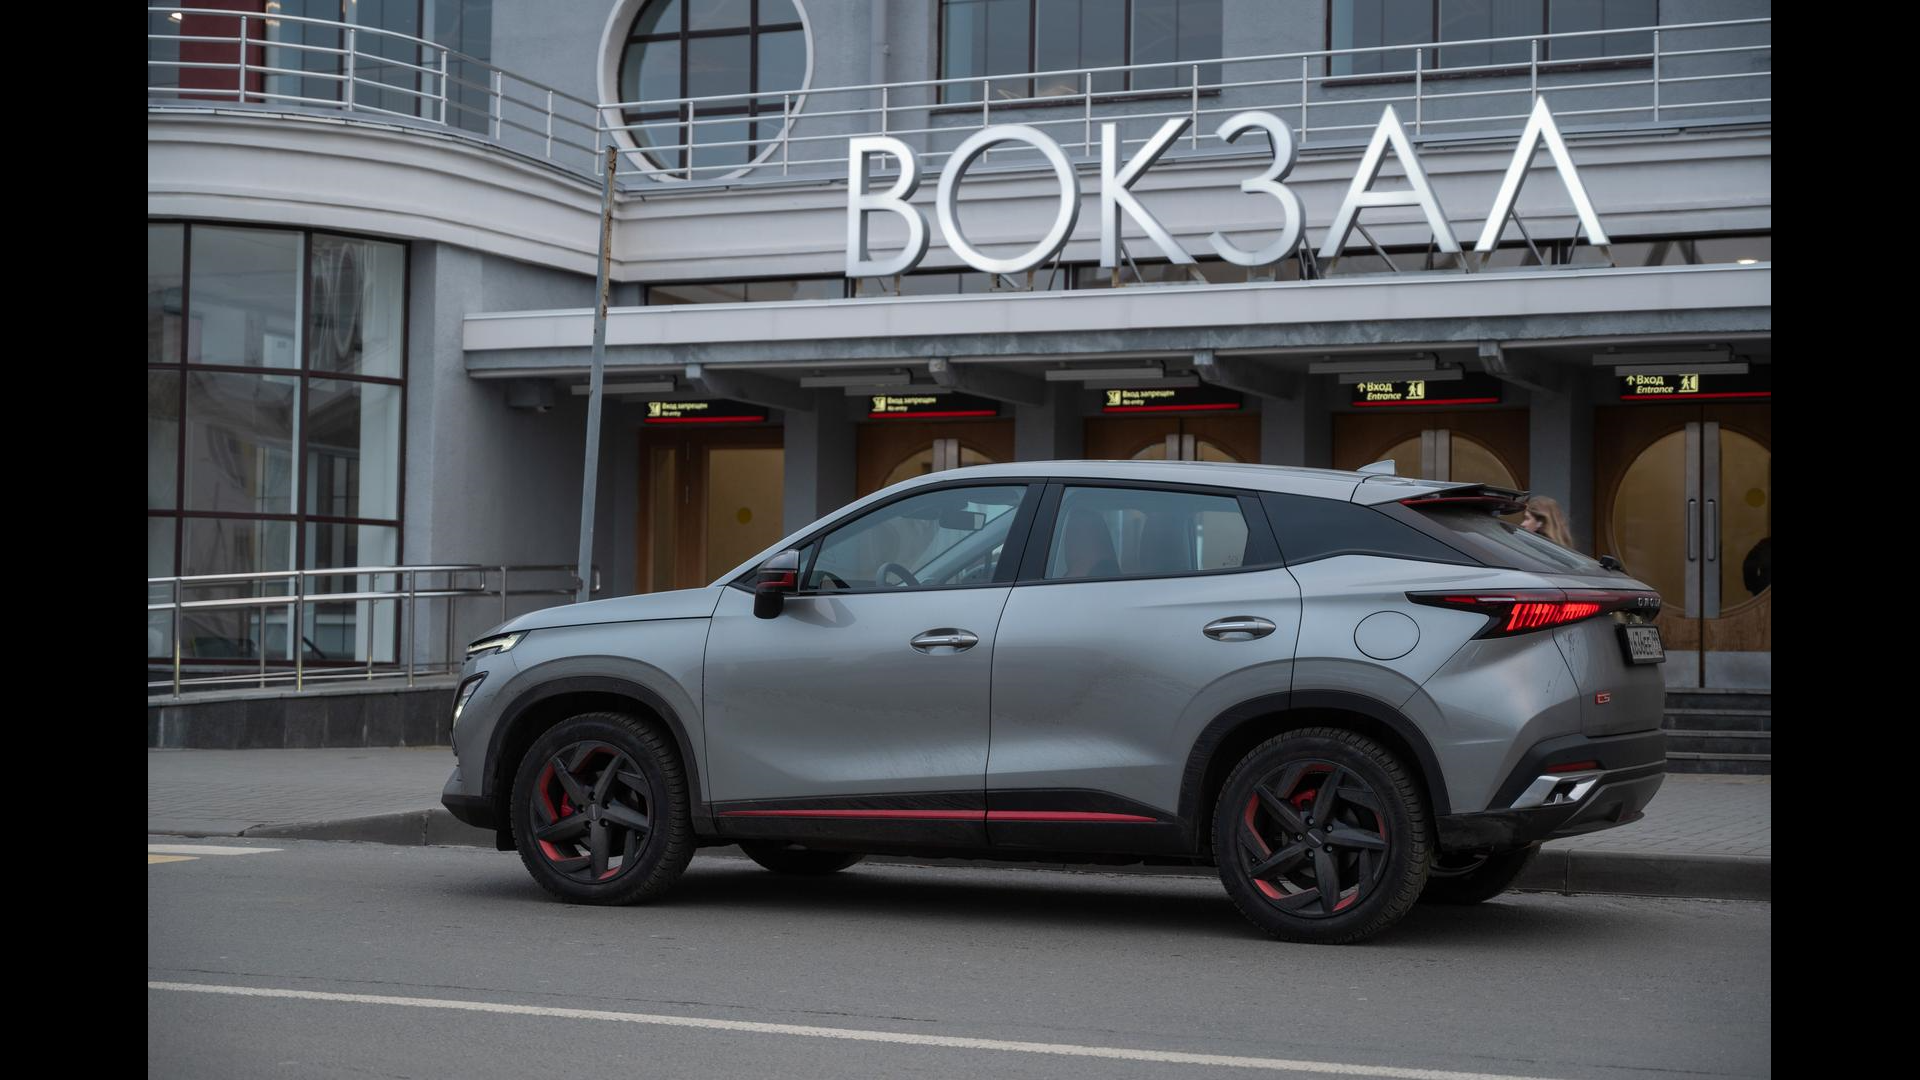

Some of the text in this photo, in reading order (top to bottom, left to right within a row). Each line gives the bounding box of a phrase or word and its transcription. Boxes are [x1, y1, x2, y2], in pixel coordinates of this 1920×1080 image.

[844, 95, 1611, 278] ВОКЗАЛ
[1636, 374, 1664, 386] Вход
[1366, 382, 1393, 392] Вход
[1636, 385, 1674, 394] Entrance
[1122, 390, 1139, 398] Вход
[1366, 392, 1402, 400] Entrance
